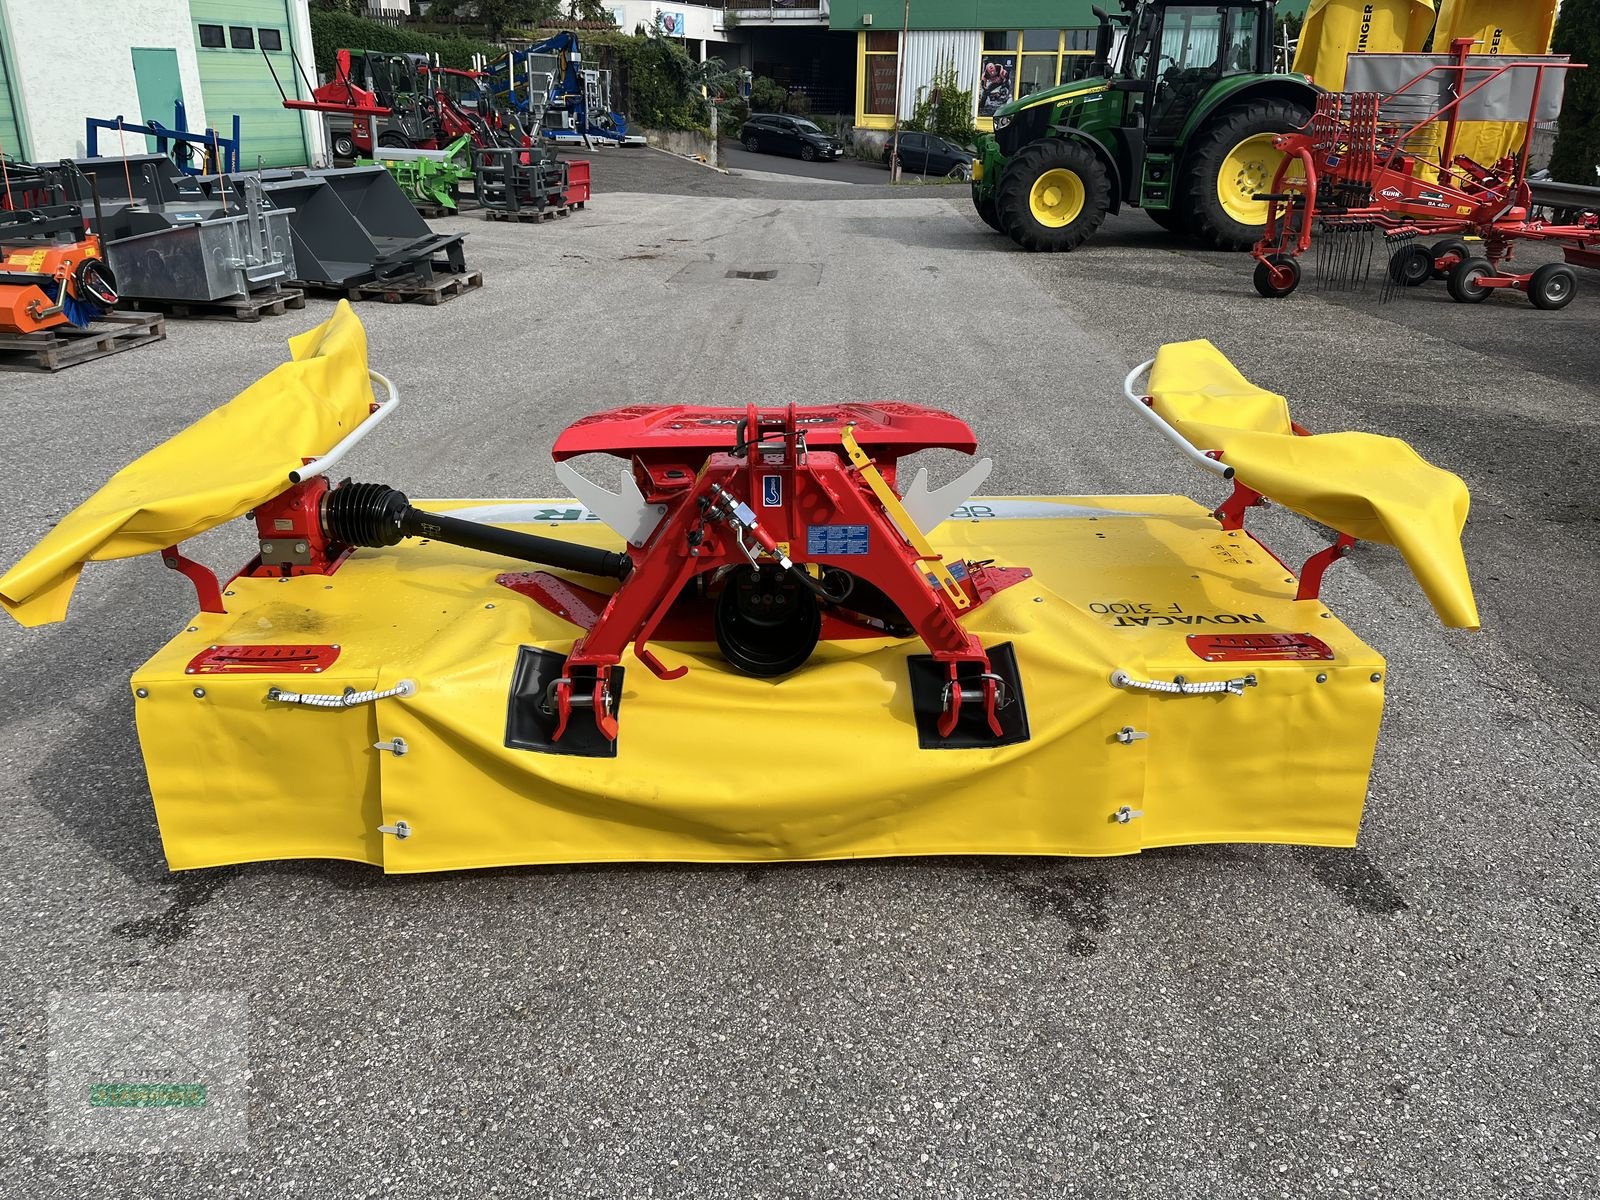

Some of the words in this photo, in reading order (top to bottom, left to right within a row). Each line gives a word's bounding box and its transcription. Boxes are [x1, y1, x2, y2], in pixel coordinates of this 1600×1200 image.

[1381, 188, 1400, 198] KUHN
[1089, 602, 1159, 615] 3100
[1167, 602, 1184, 614] F
[1113, 613, 1266, 627] NOVACAT
